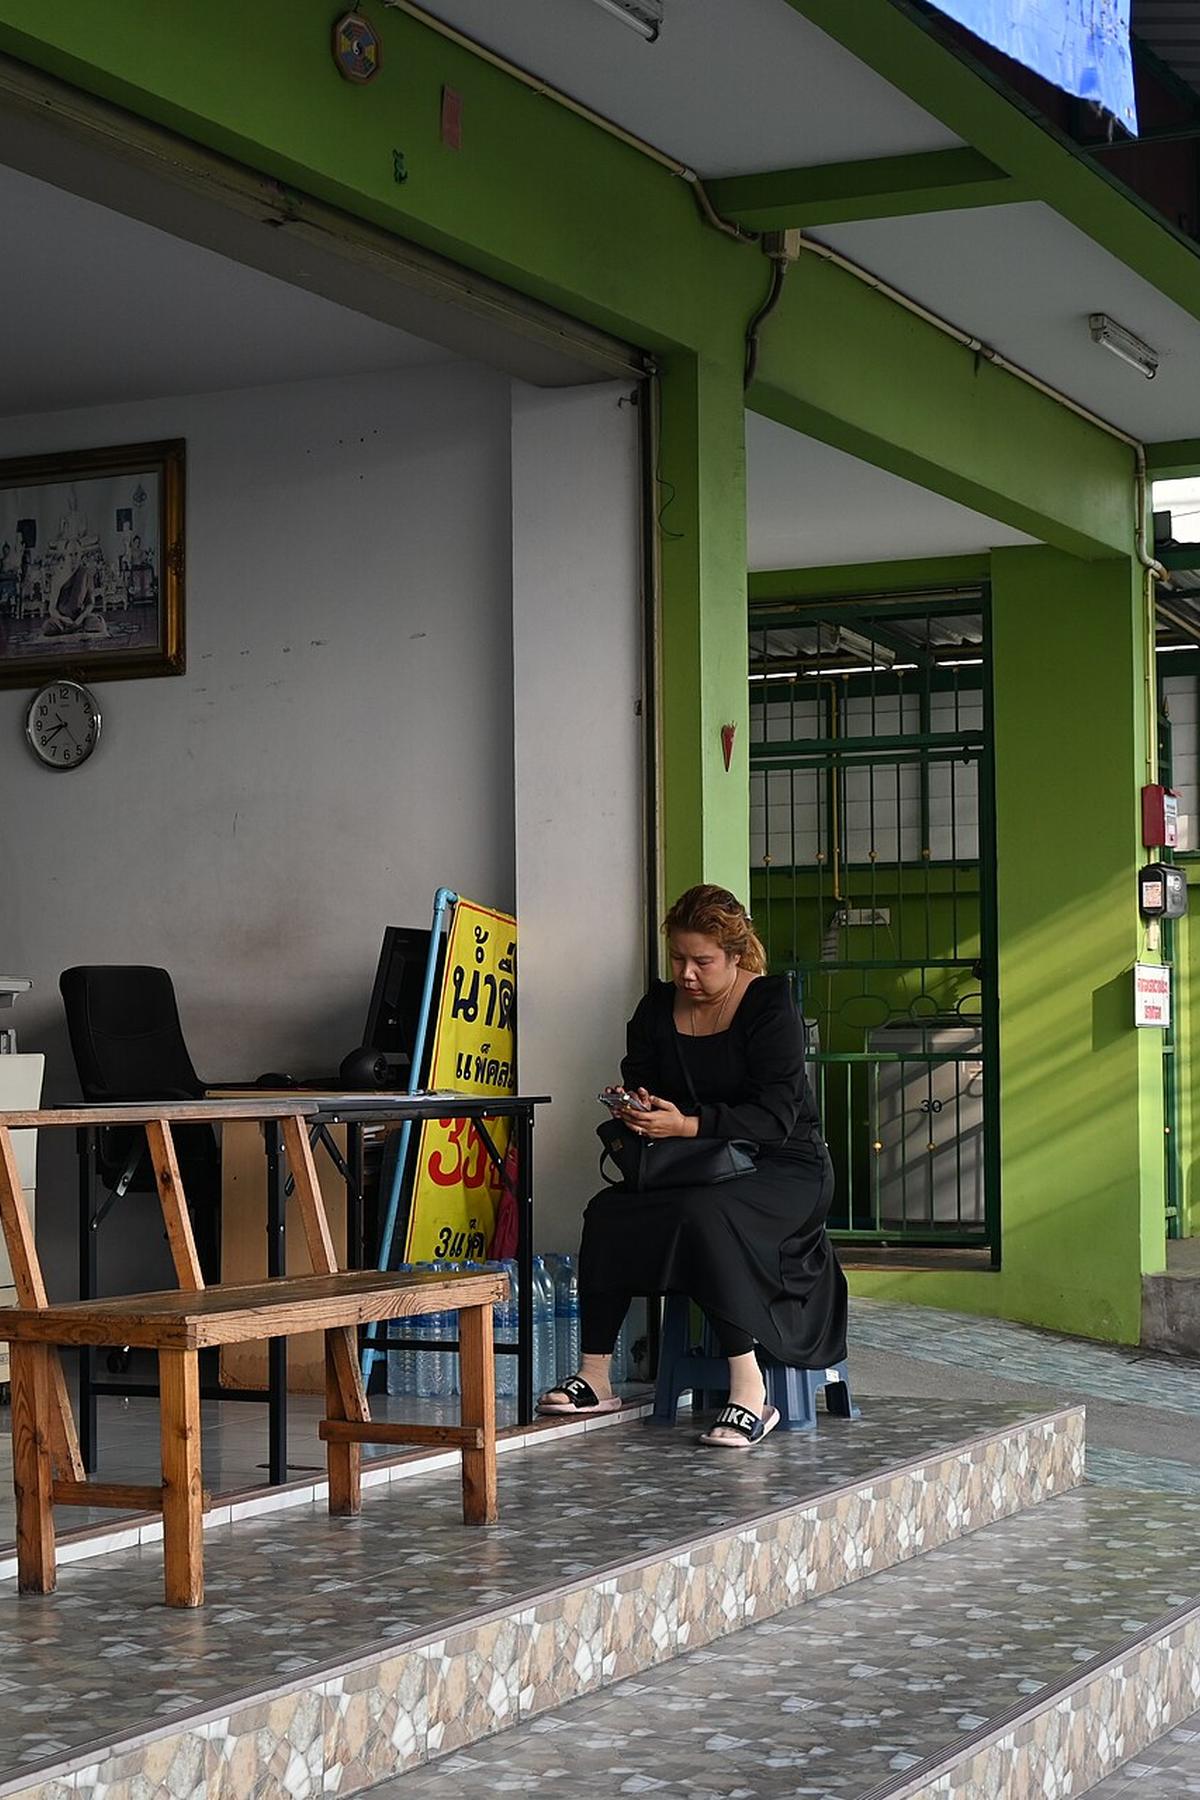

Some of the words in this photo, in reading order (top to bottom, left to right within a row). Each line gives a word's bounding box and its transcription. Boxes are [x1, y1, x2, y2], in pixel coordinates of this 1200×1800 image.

[49, 693, 56, 704] 11
[60, 688, 69, 699] 12
[38, 705, 48, 716] 10
[83, 703, 91, 714] 2
[36, 720, 43, 731] 9
[88, 718, 95, 729] 3
[41, 735, 47, 746] 8
[85, 733, 91, 743] 4
[51, 746, 57, 757] 7
[64, 749, 70, 760] 6
[76, 745, 83, 756] 5
[717, 1407, 756, 1431] IKE
